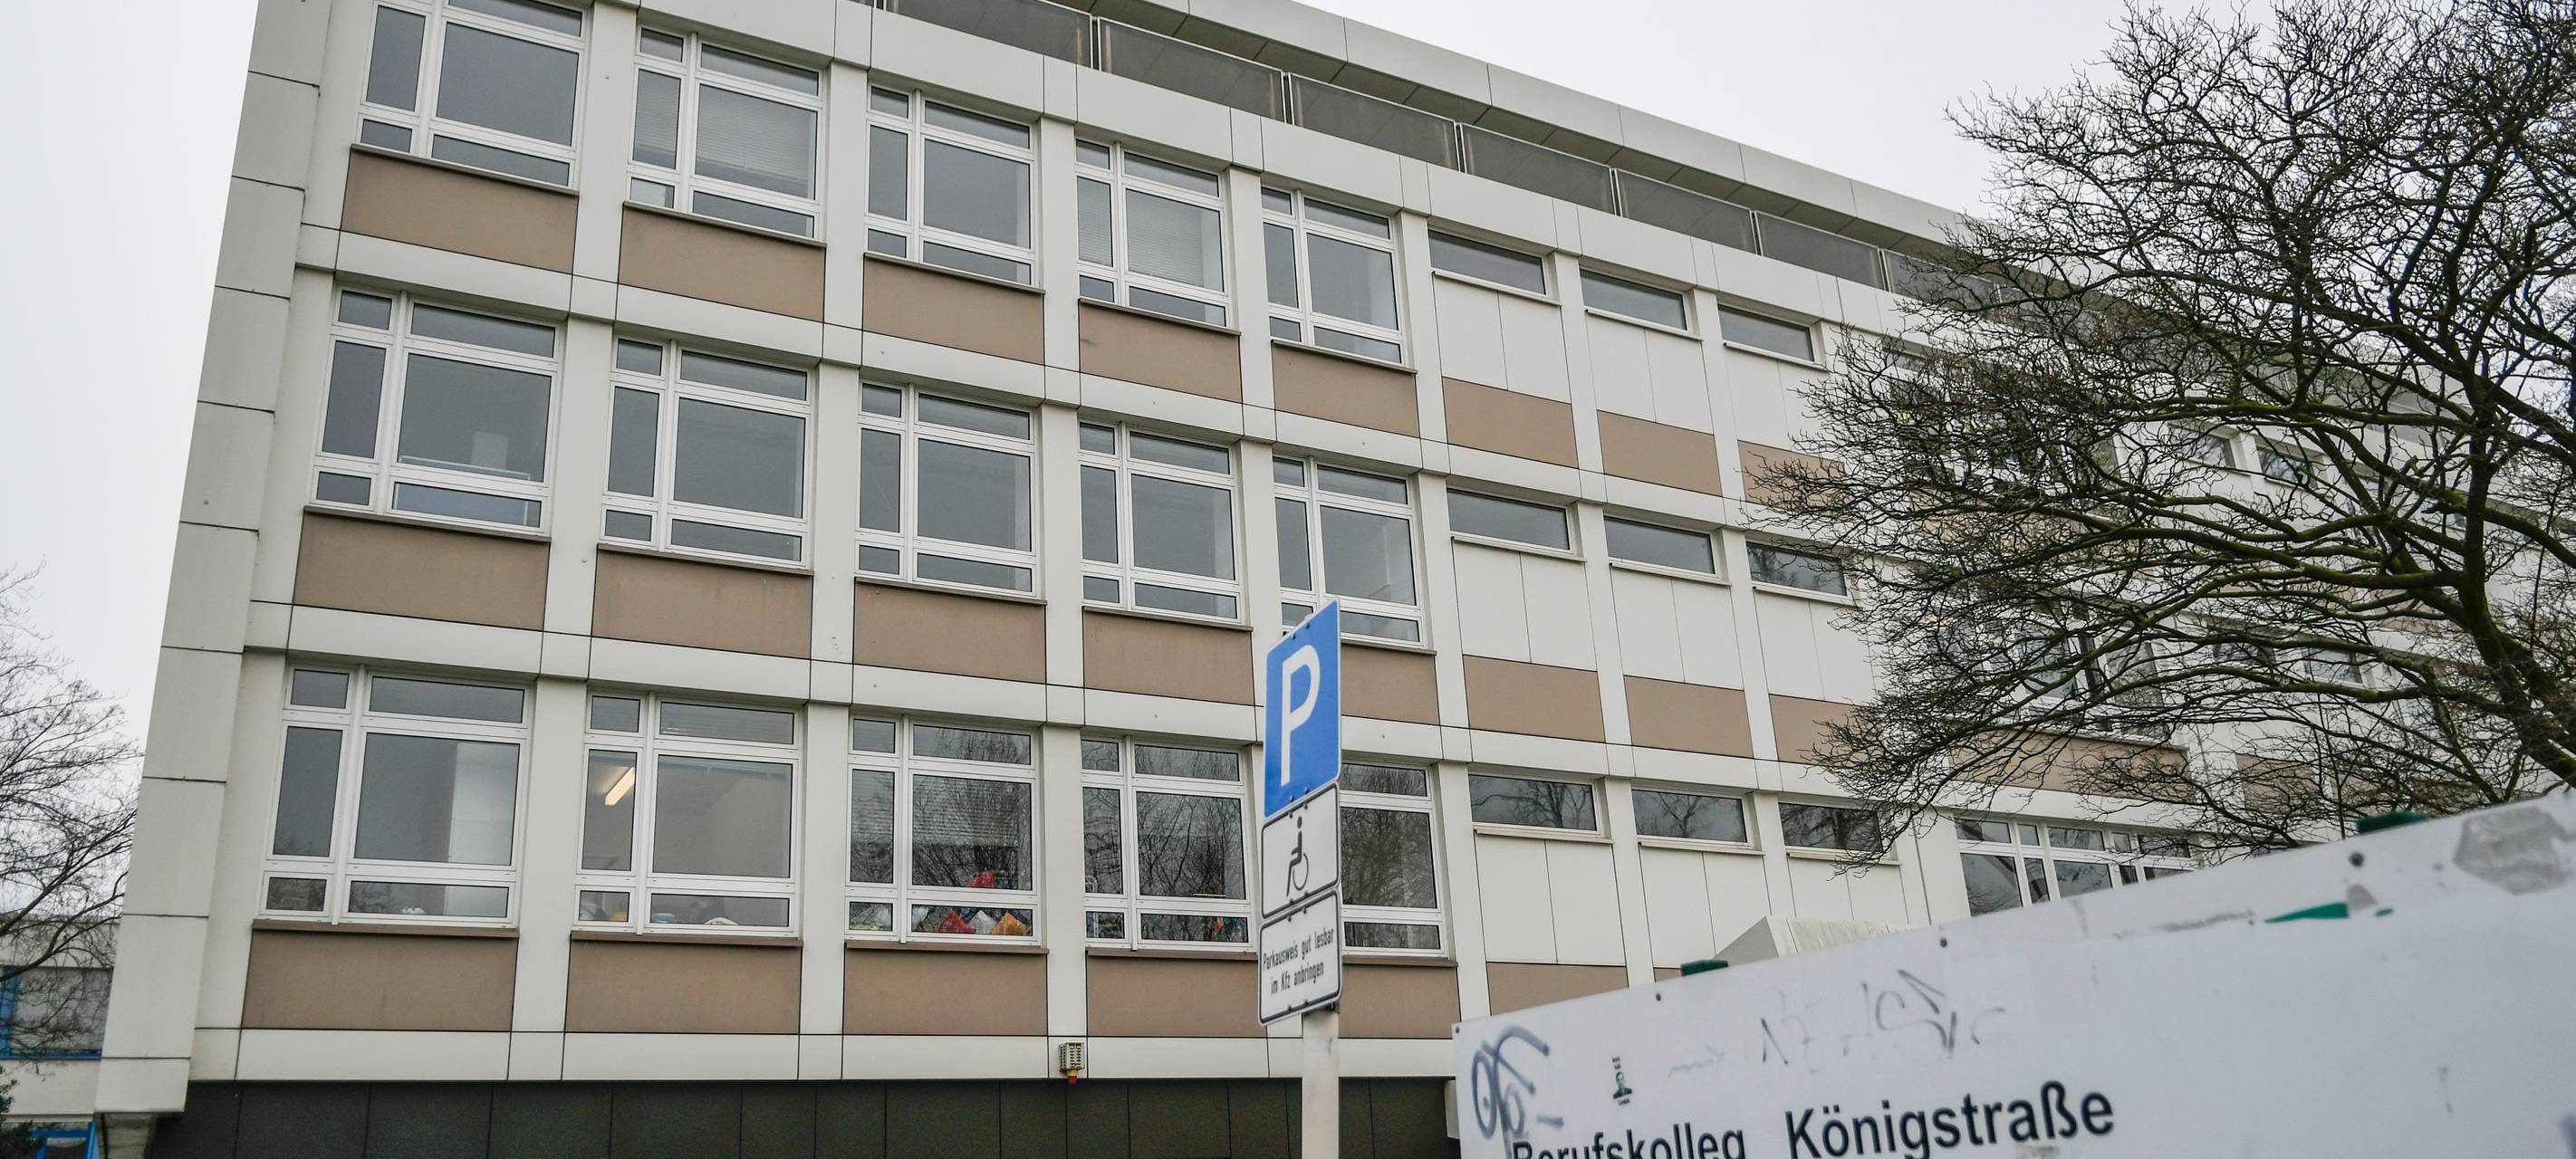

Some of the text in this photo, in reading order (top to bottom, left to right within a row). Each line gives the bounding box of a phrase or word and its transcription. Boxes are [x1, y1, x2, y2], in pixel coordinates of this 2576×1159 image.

[1280, 644, 1321, 786] P
[1263, 927, 1334, 971] Parkausweis gut lesbar
[1271, 962, 1324, 994] im Kfz anbringen
[1784, 1080, 2114, 1159] Königstraße
